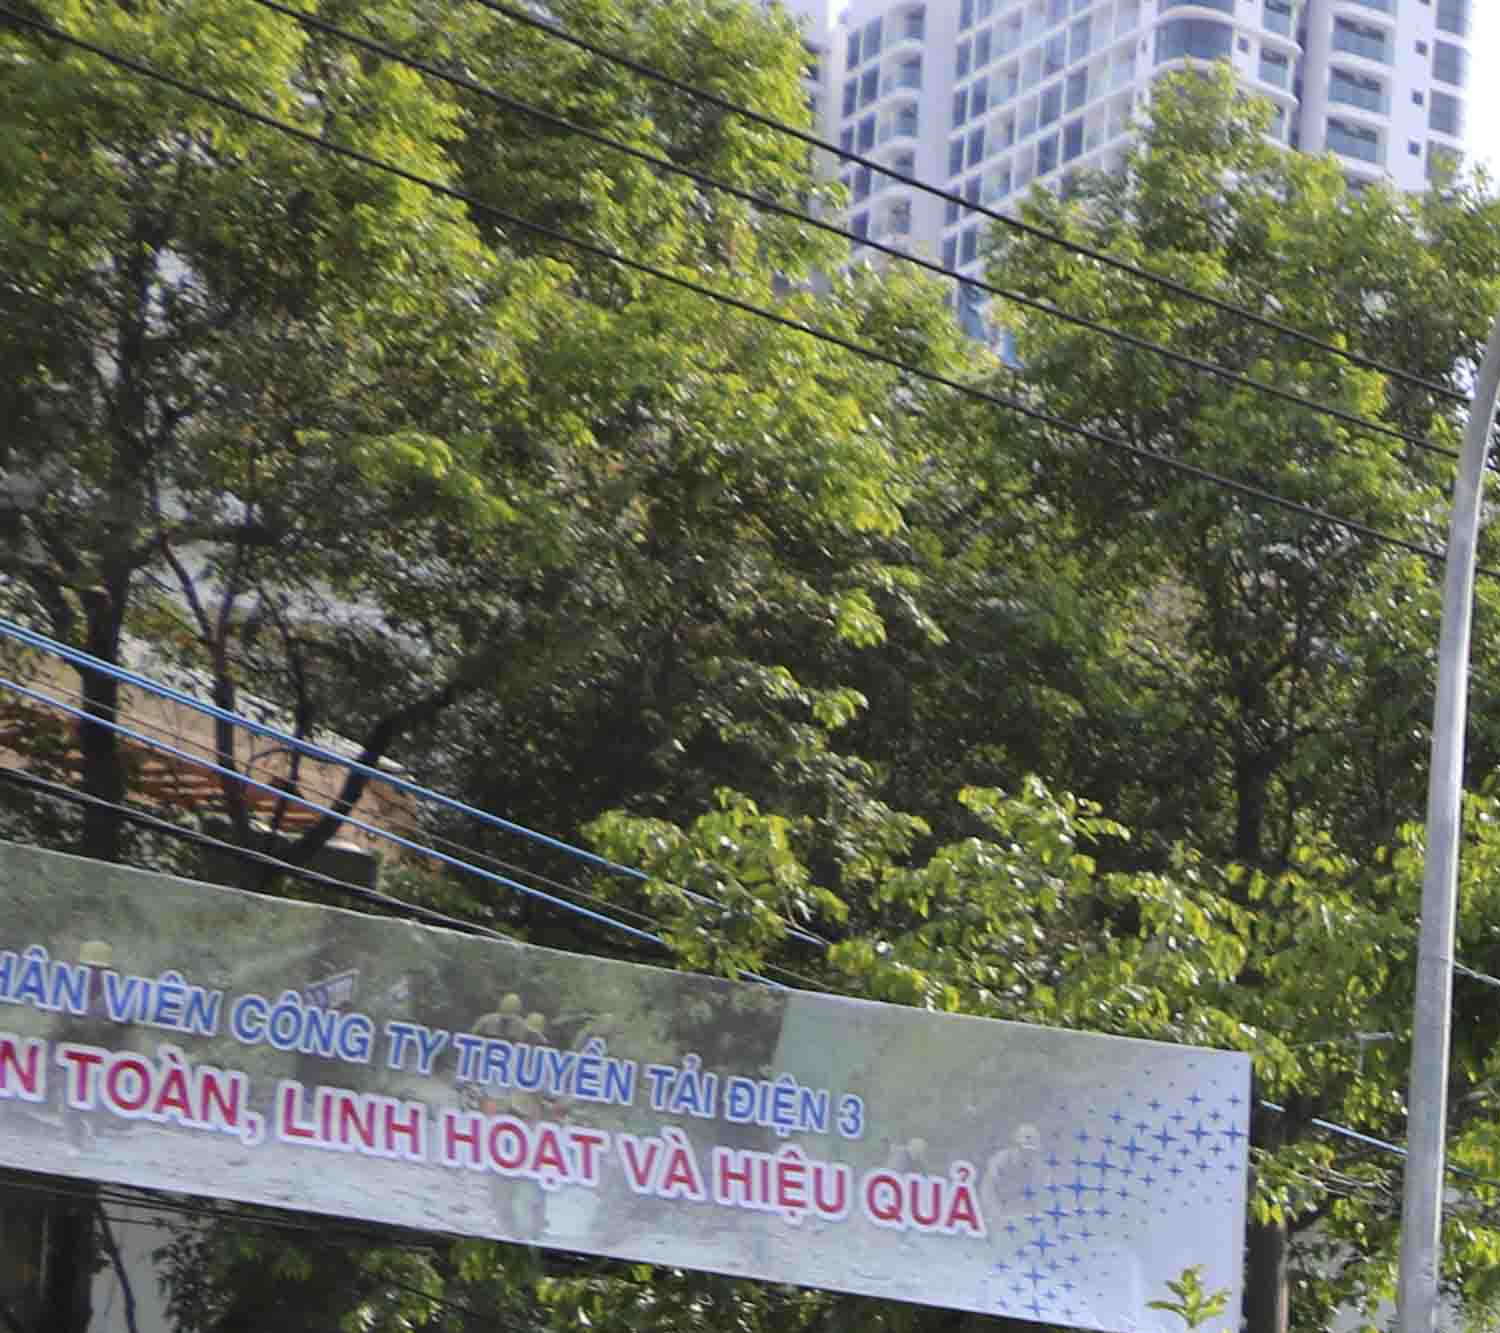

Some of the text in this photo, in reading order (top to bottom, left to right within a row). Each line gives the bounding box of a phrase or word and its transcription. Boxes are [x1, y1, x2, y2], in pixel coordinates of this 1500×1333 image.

[0, 947, 862, 1137] ÂN VIÊN CÔNG TY TRUYỀN TẢI ĐIỆN 3
[64, 1049, 260, 1137] TOÀN,
[283, 1085, 421, 1155] LINH
[445, 1113, 603, 1185] HOẠT
[623, 1133, 699, 1193] VÀ
[719, 1148, 845, 1218] HIỆU
[866, 1165, 980, 1231] QUẢ
